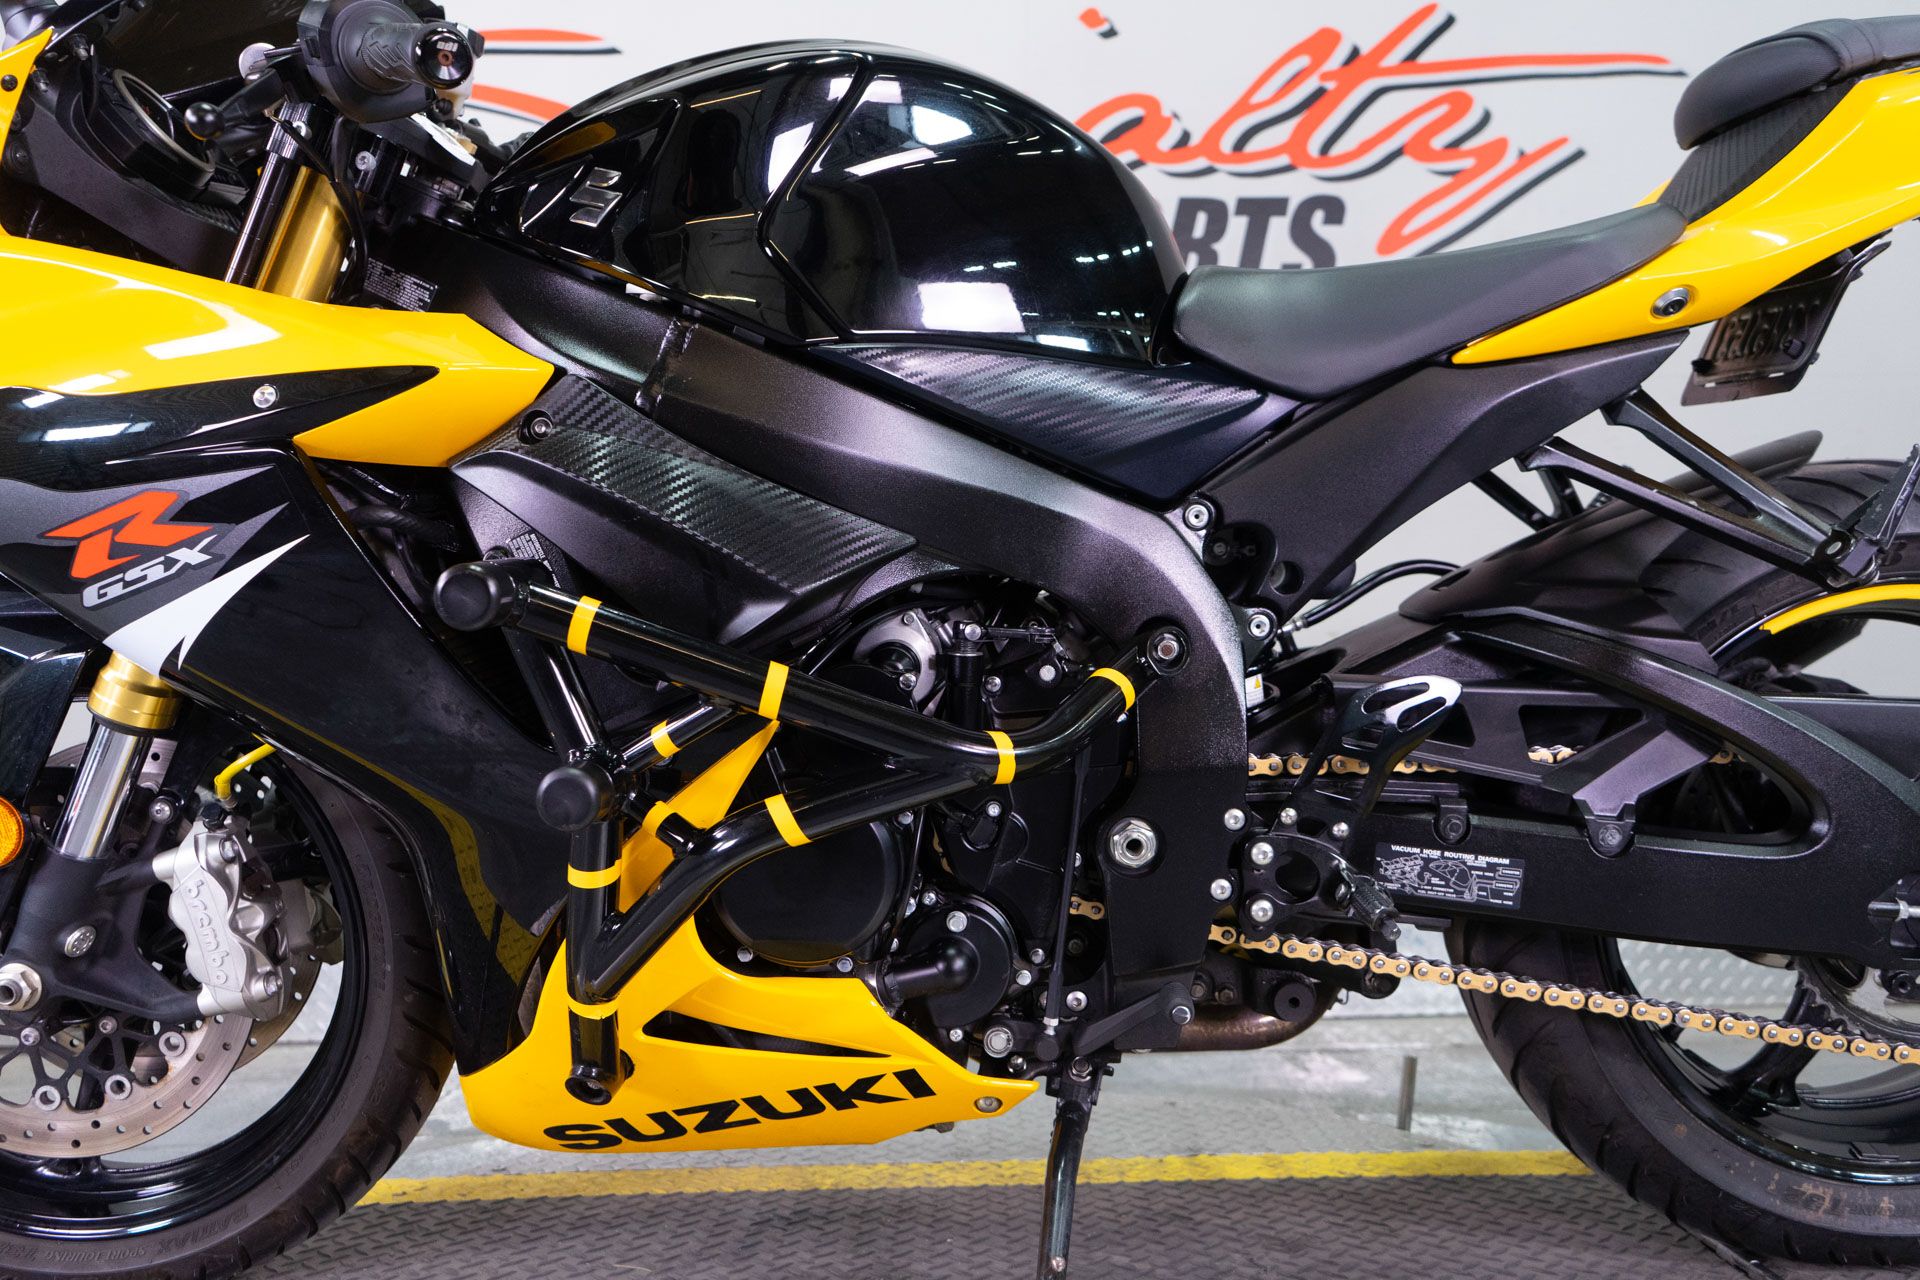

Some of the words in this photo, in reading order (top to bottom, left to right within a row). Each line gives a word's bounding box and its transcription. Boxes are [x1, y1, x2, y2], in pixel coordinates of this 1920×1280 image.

[83, 534, 217, 608] GSX
[1391, 844, 1420, 854] VACUUM
[1423, 848, 1441, 857] HOSE
[1444, 851, 1475, 861] ROUTING
[1478, 855, 1510, 865] DIAGRAM
[185, 879, 229, 985] brembo
[544, 1068, 937, 1150] SUZUKI
